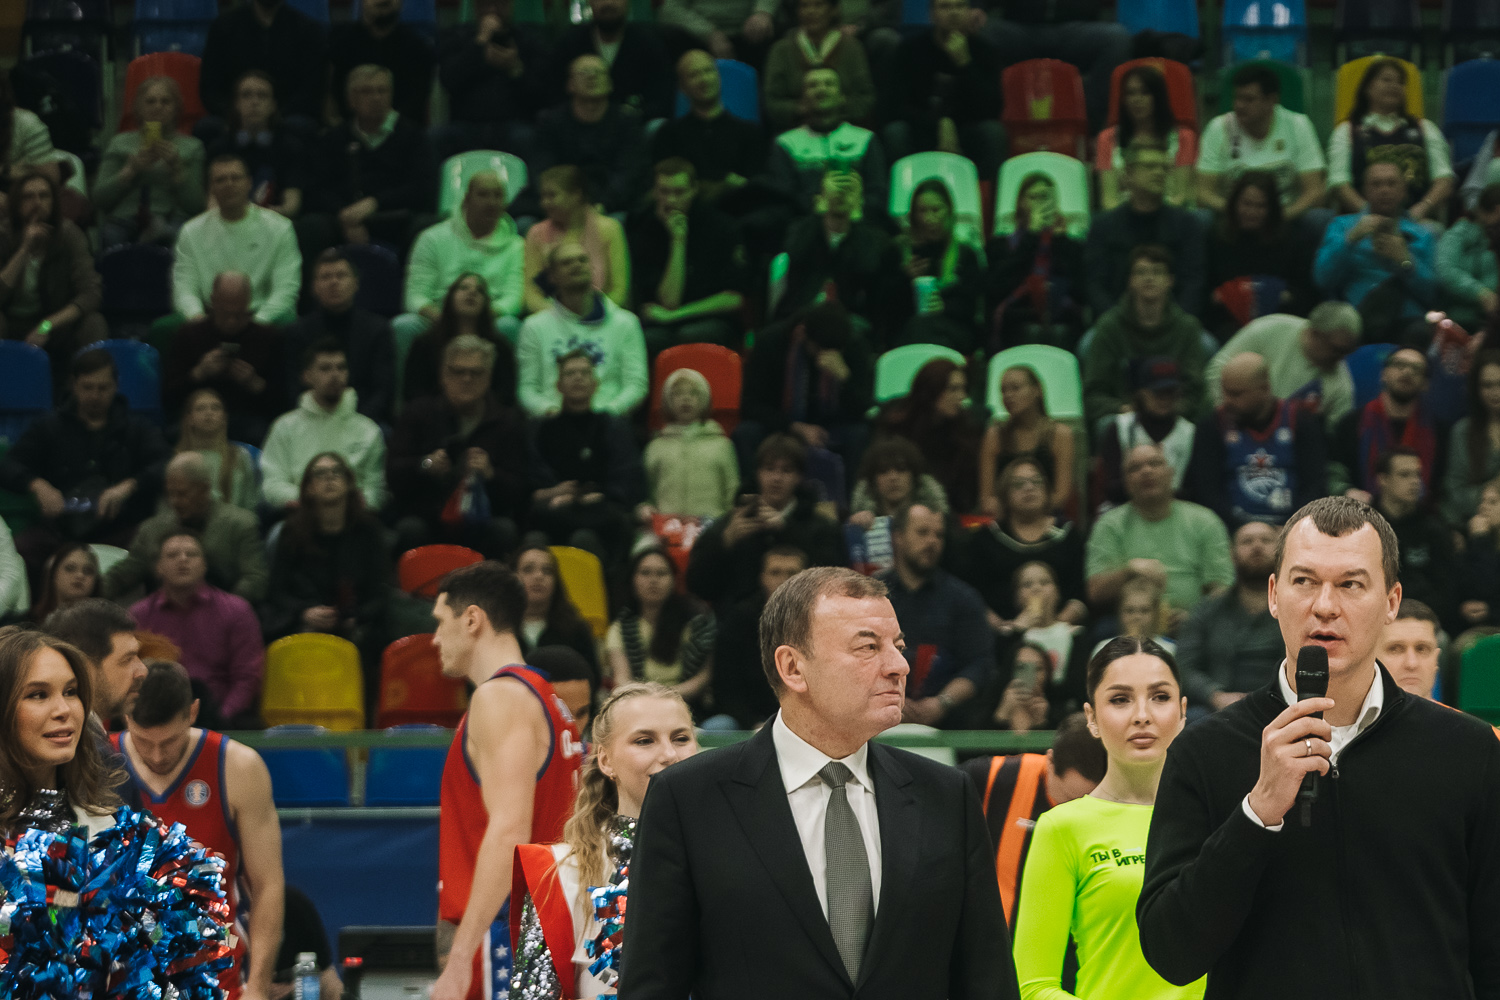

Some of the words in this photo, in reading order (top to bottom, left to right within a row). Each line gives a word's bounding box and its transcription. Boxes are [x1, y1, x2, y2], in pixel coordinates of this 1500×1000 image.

[1090, 851, 1110, 863] ТЫ
[1112, 848, 1122, 858] В
[1115, 854, 1145, 867] ИГРЕ
